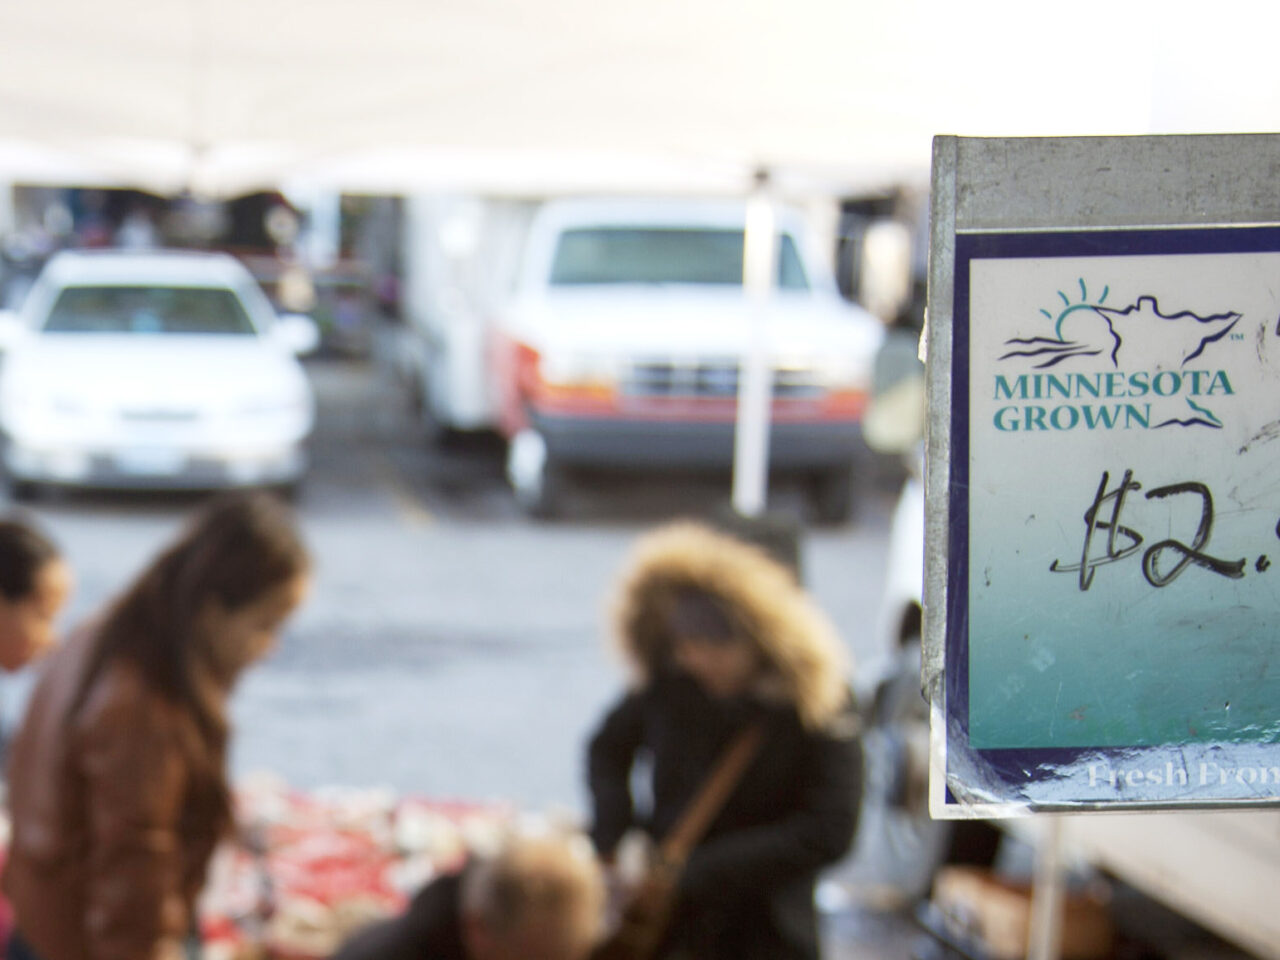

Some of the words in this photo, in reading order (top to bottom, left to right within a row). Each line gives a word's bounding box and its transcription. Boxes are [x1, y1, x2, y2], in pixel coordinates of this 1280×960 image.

[993, 370, 1235, 400] MINNESOTA
[993, 403, 1152, 432] GROWN
[1049, 469, 1280, 592] $2.
[1088, 761, 1188, 787] Fresh
